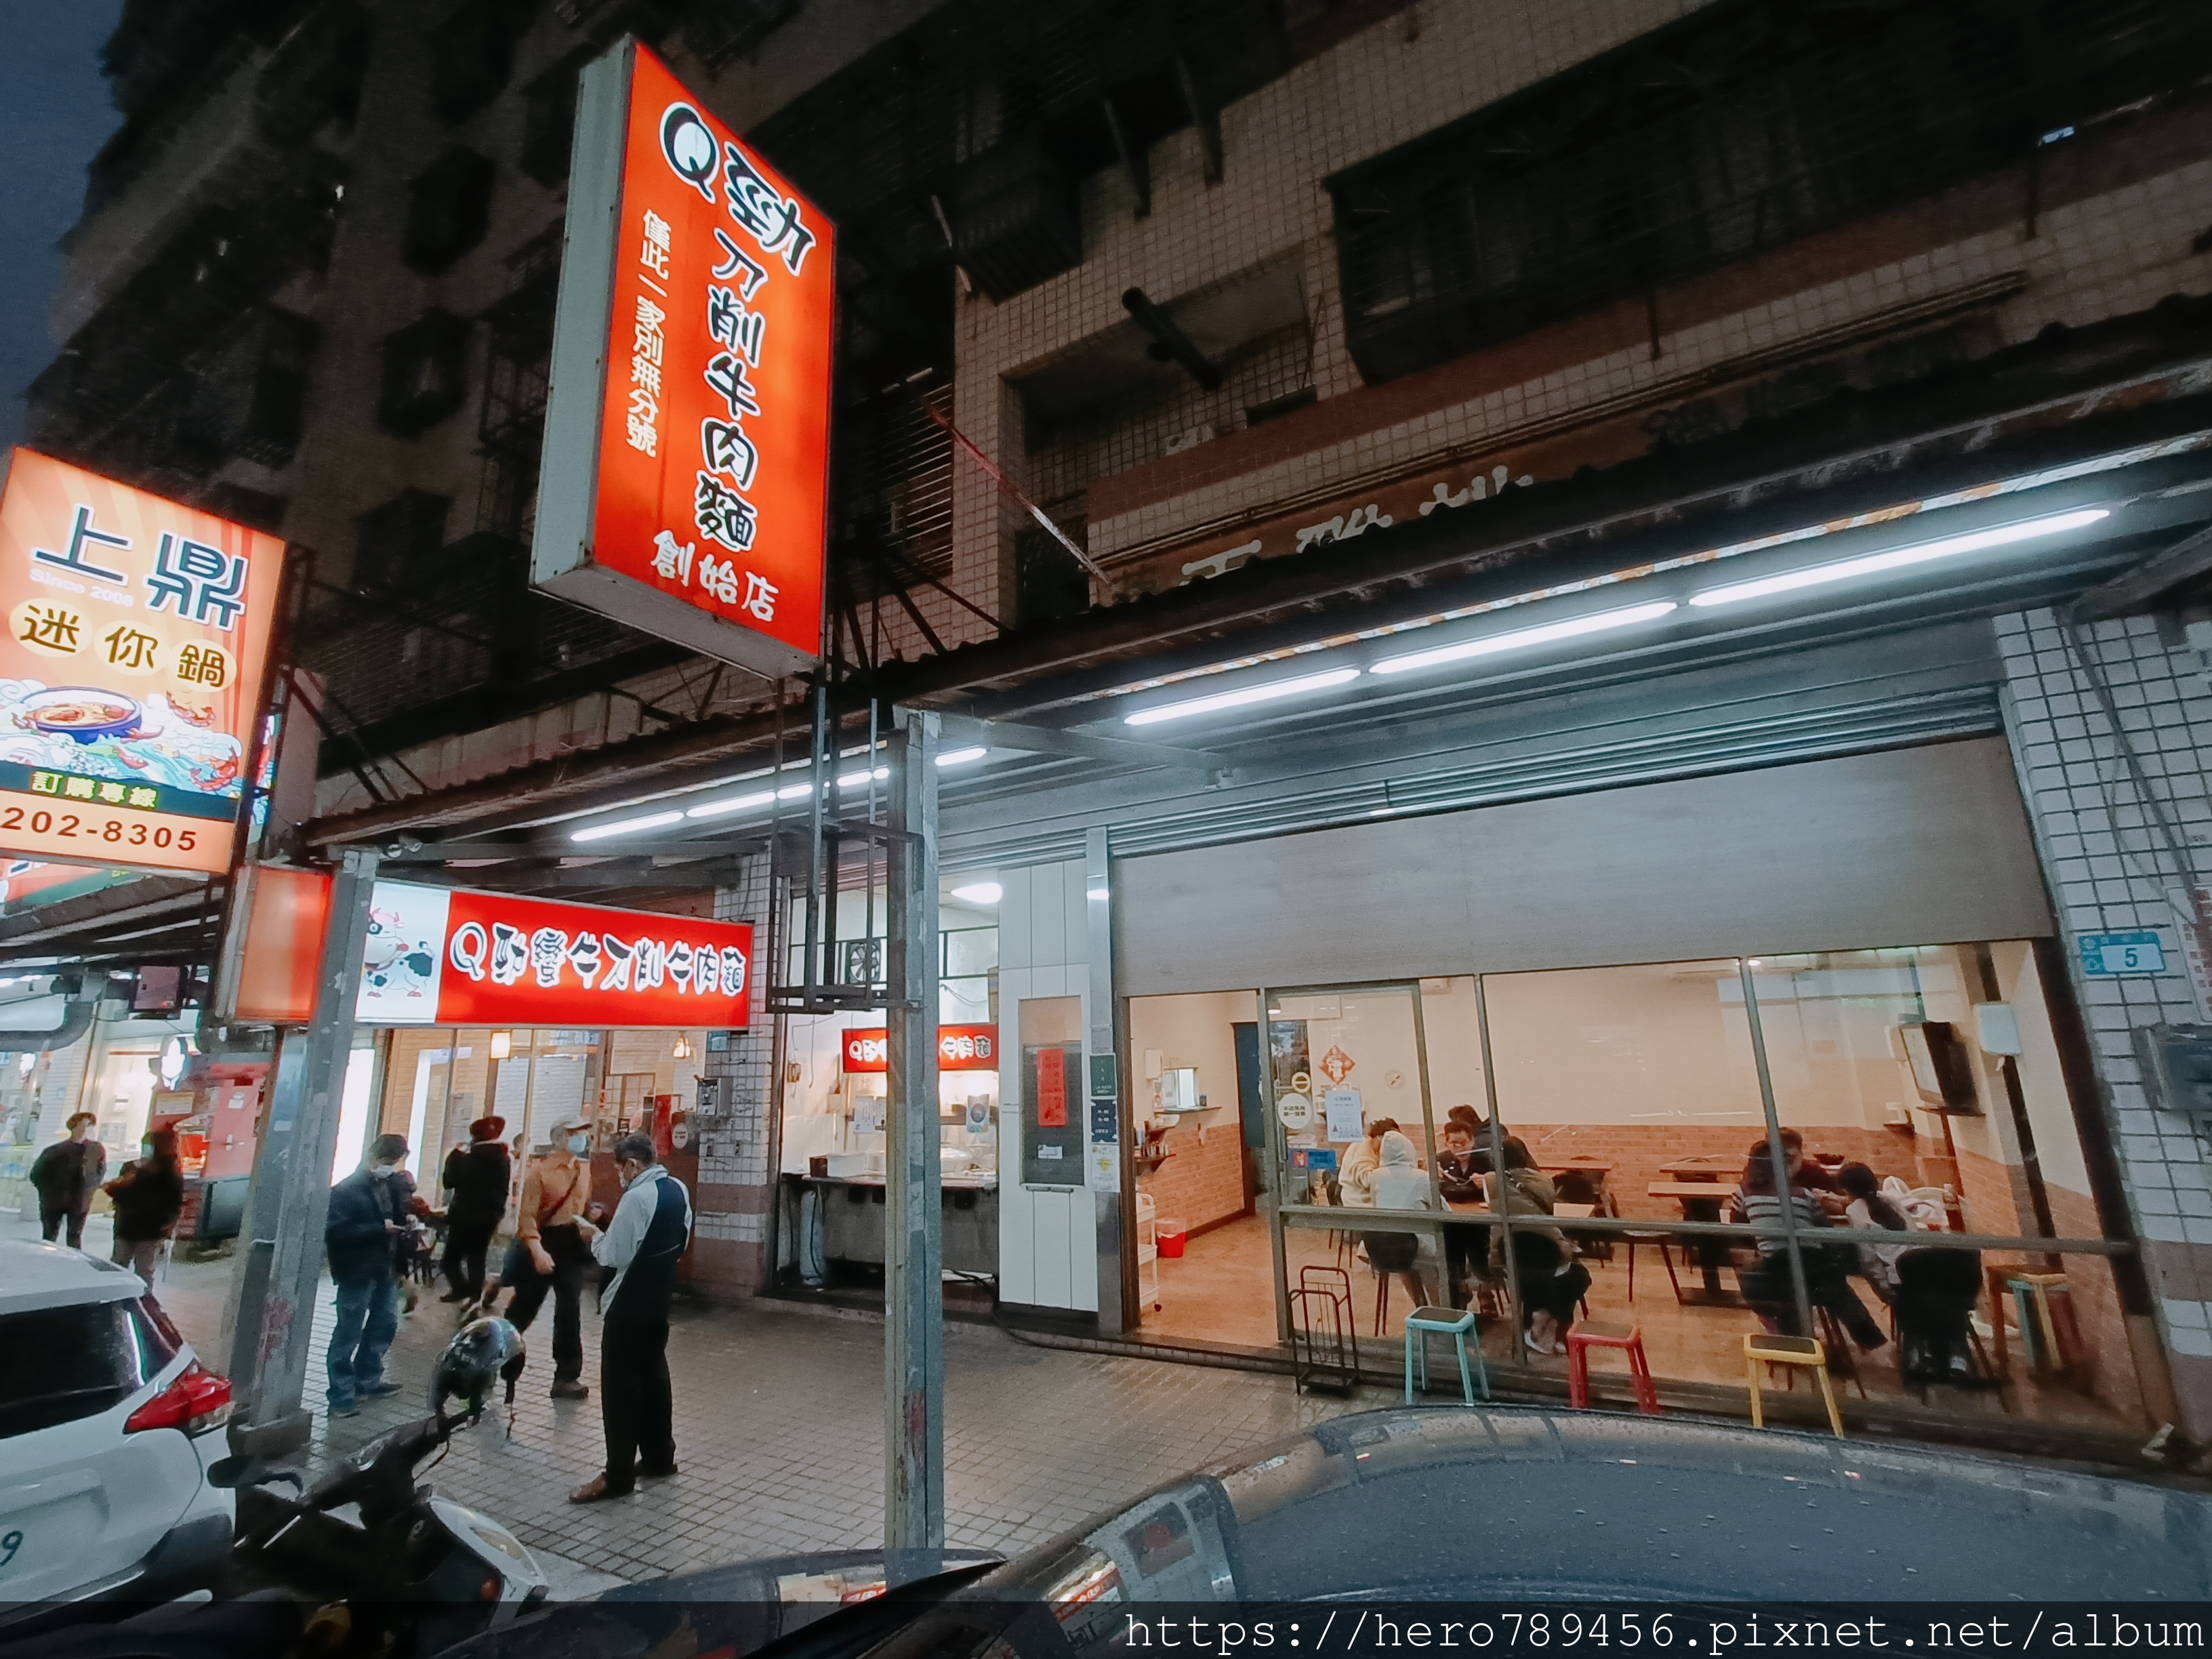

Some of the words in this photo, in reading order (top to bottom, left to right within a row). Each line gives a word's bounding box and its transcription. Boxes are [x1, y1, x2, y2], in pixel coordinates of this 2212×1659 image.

[626, 208, 672, 458] 僅此一家別無分號
[695, 227, 769, 552] 刀削牛肉麵
[29, 568, 85, 594] Since
[89, 586, 134, 607] 2008
[31, 503, 248, 632] 上鼎
[652, 529, 779, 622] 創始店
[19, 604, 226, 688] 迷你鍋
[32, 771, 158, 808] 訂購專線
[2125, 947, 2138, 967] 5
